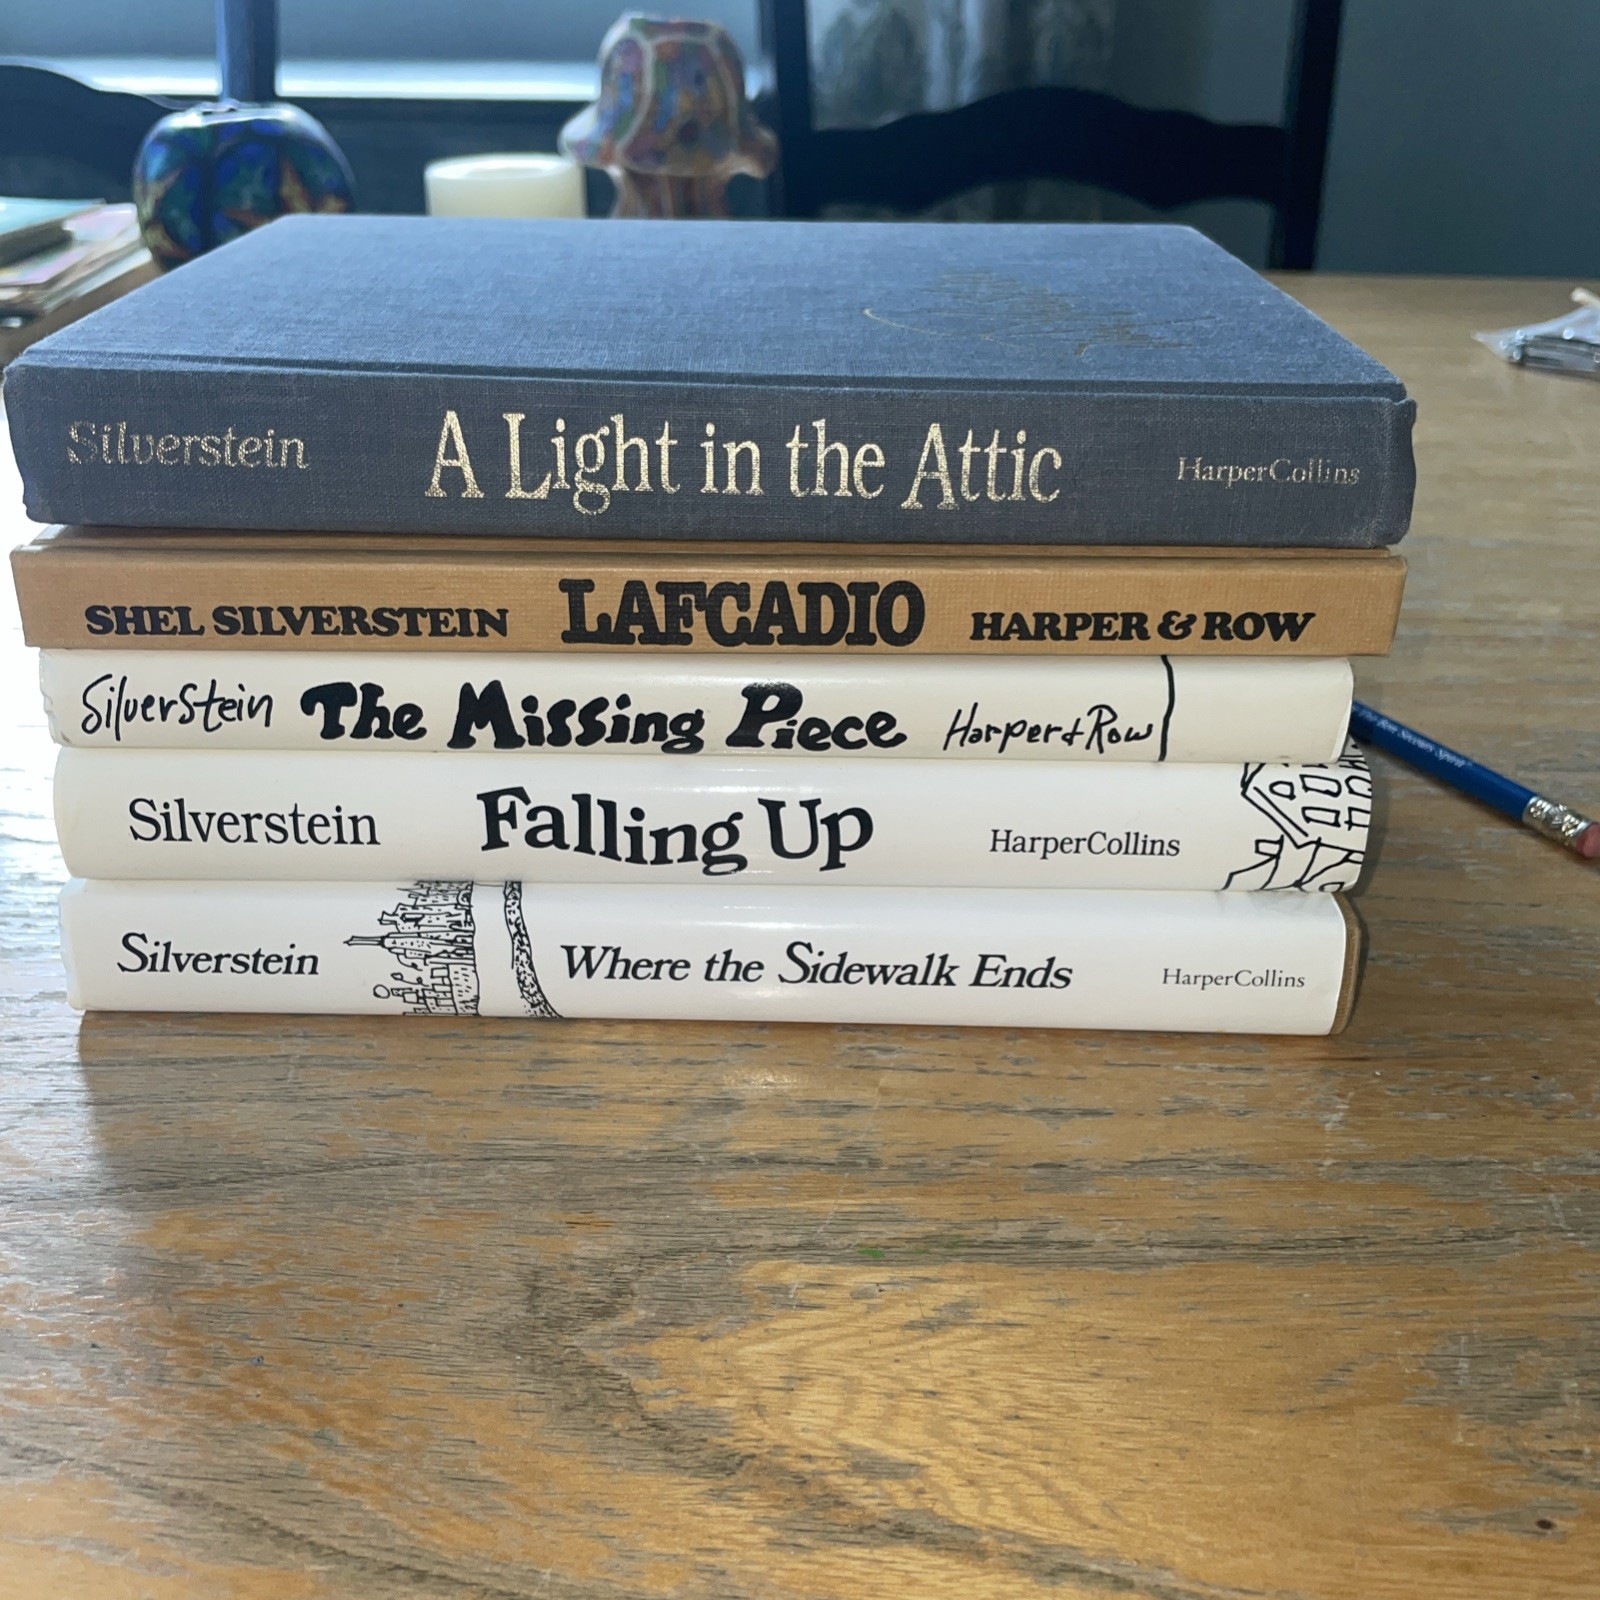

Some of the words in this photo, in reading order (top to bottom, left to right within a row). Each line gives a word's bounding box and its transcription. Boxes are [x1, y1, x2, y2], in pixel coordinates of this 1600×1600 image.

[69, 422, 308, 468] Silverstein
[425, 410, 484, 498] A
[503, 413, 680, 515] Light
[700, 423, 764, 495] in
[786, 418, 885, 499] the
[901, 423, 1062, 510] Attic
[1178, 457, 1359, 487] HarperCollins
[85, 606, 205, 635] SHEL
[213, 606, 508, 637] SILVERSTEIN
[559, 579, 925, 647] LAFCADIO
[970, 612, 1150, 641] HARPER
[1158, 611, 1196, 640] &
[1201, 612, 1316, 641] ROW
[81, 674, 273, 741] Silverstein
[300, 682, 427, 740] The
[447, 680, 705, 755] Missing
[725, 683, 907, 751] Piece
[943, 702, 1062, 754] Harper
[1084, 704, 1153, 754] Row
[129, 798, 381, 845] Silverstein
[477, 787, 746, 876] Falling
[758, 798, 873, 872] Up
[990, 829, 1179, 860] HarperCollins
[117, 933, 318, 975] Silverstein
[560, 945, 691, 981] Where
[704, 949, 764, 982] the
[778, 941, 959, 986] Sidewalk
[968, 954, 1072, 989] Ends
[1163, 969, 1304, 990] HarperCollins
